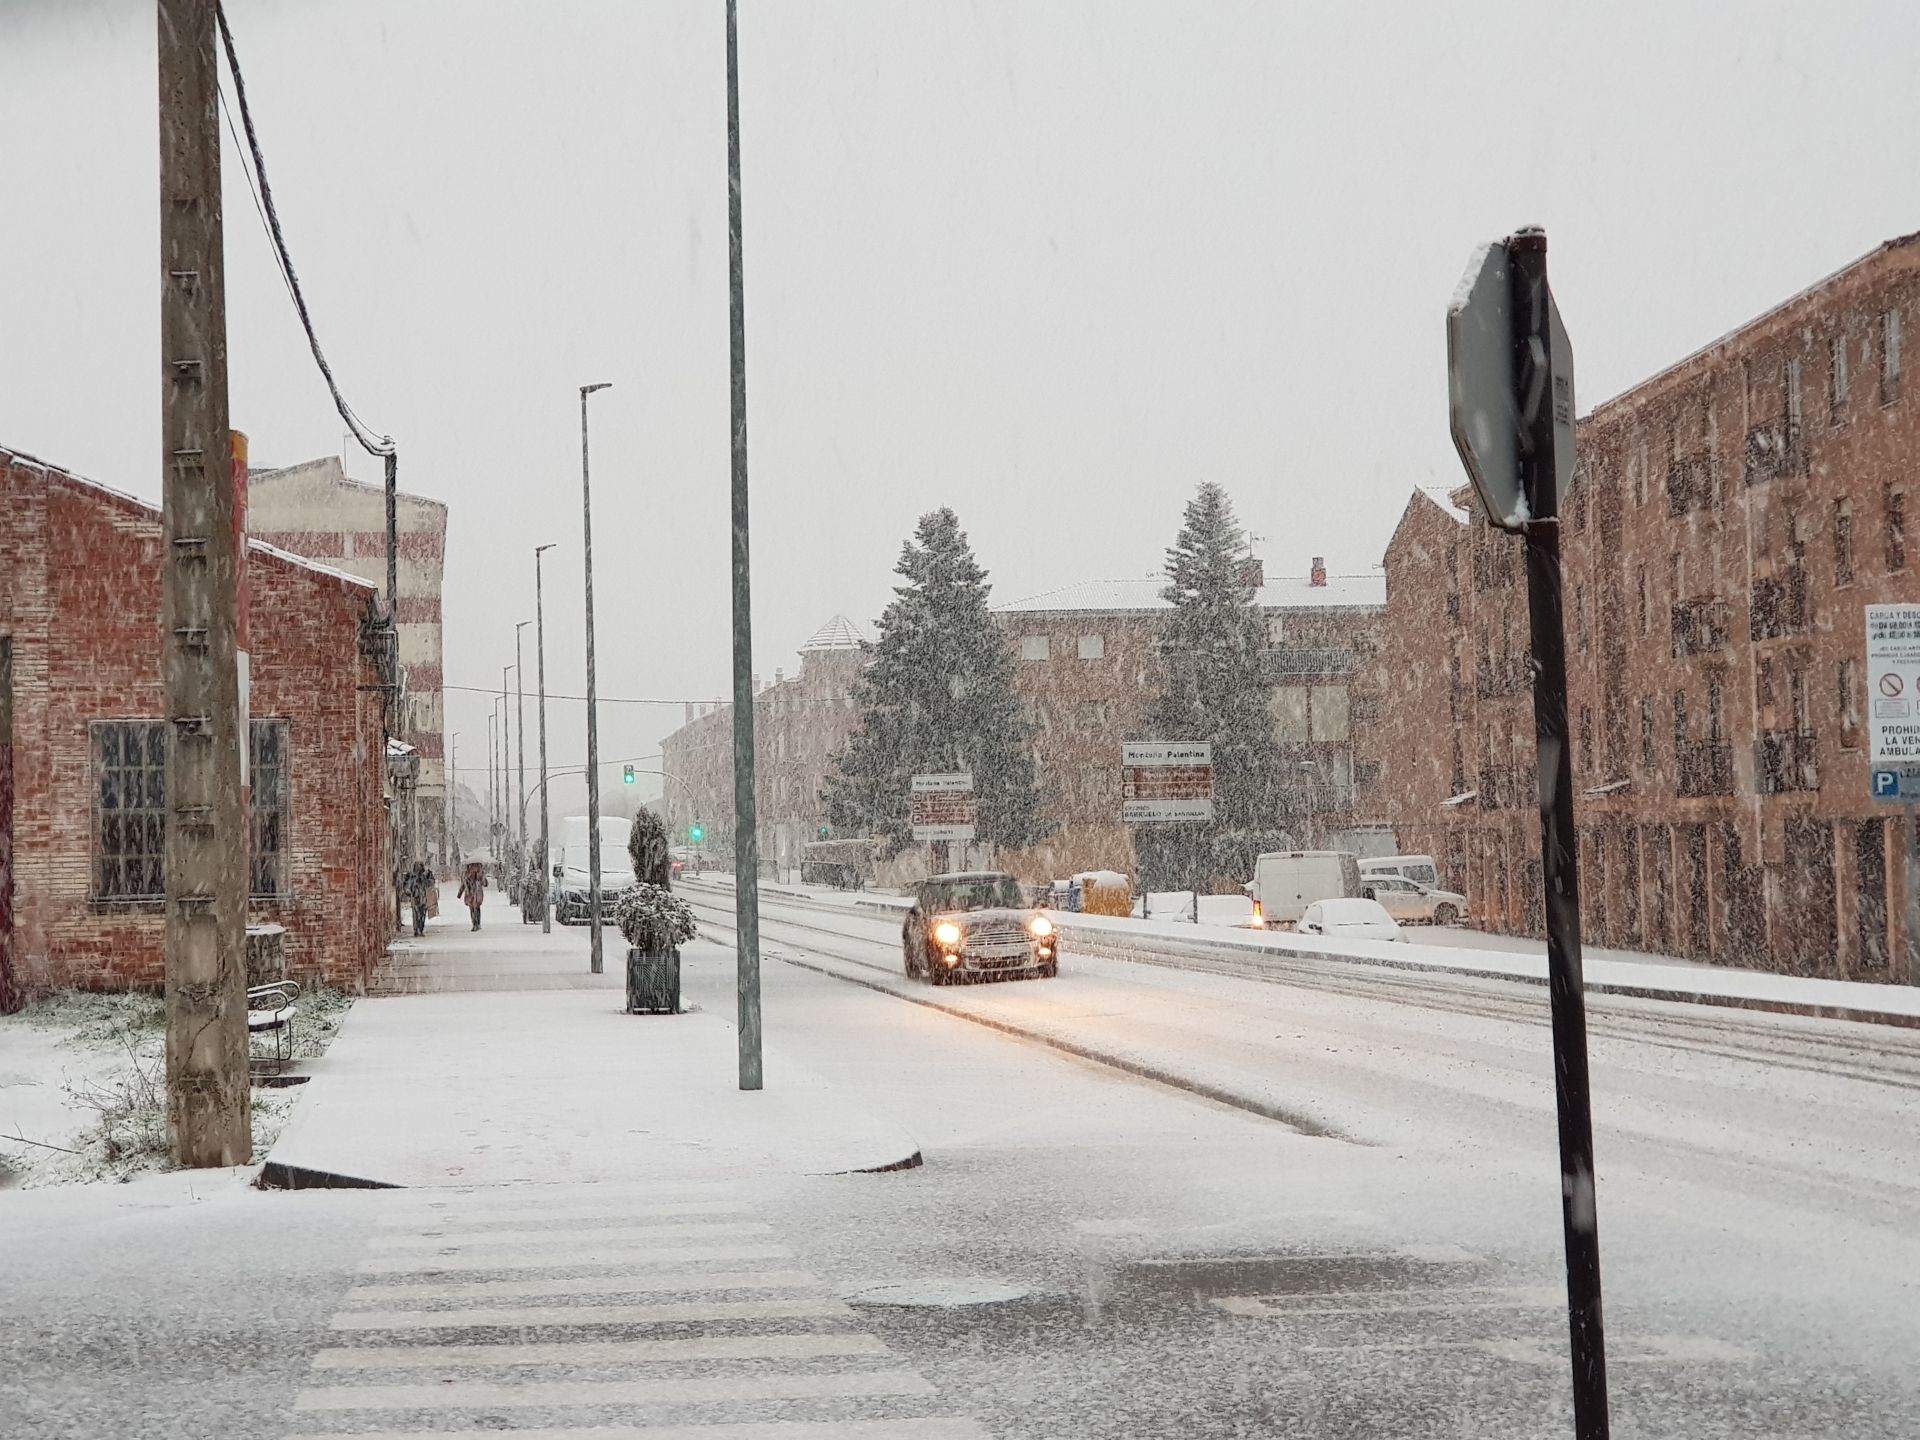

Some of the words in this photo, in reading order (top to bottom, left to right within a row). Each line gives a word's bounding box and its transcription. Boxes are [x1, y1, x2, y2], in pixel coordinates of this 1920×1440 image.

[1870, 611, 1894, 619] CARGA
[1885, 736, 1898, 745] LA
[1167, 750, 1205, 758] Palentina
[1877, 772, 1893, 794] P
